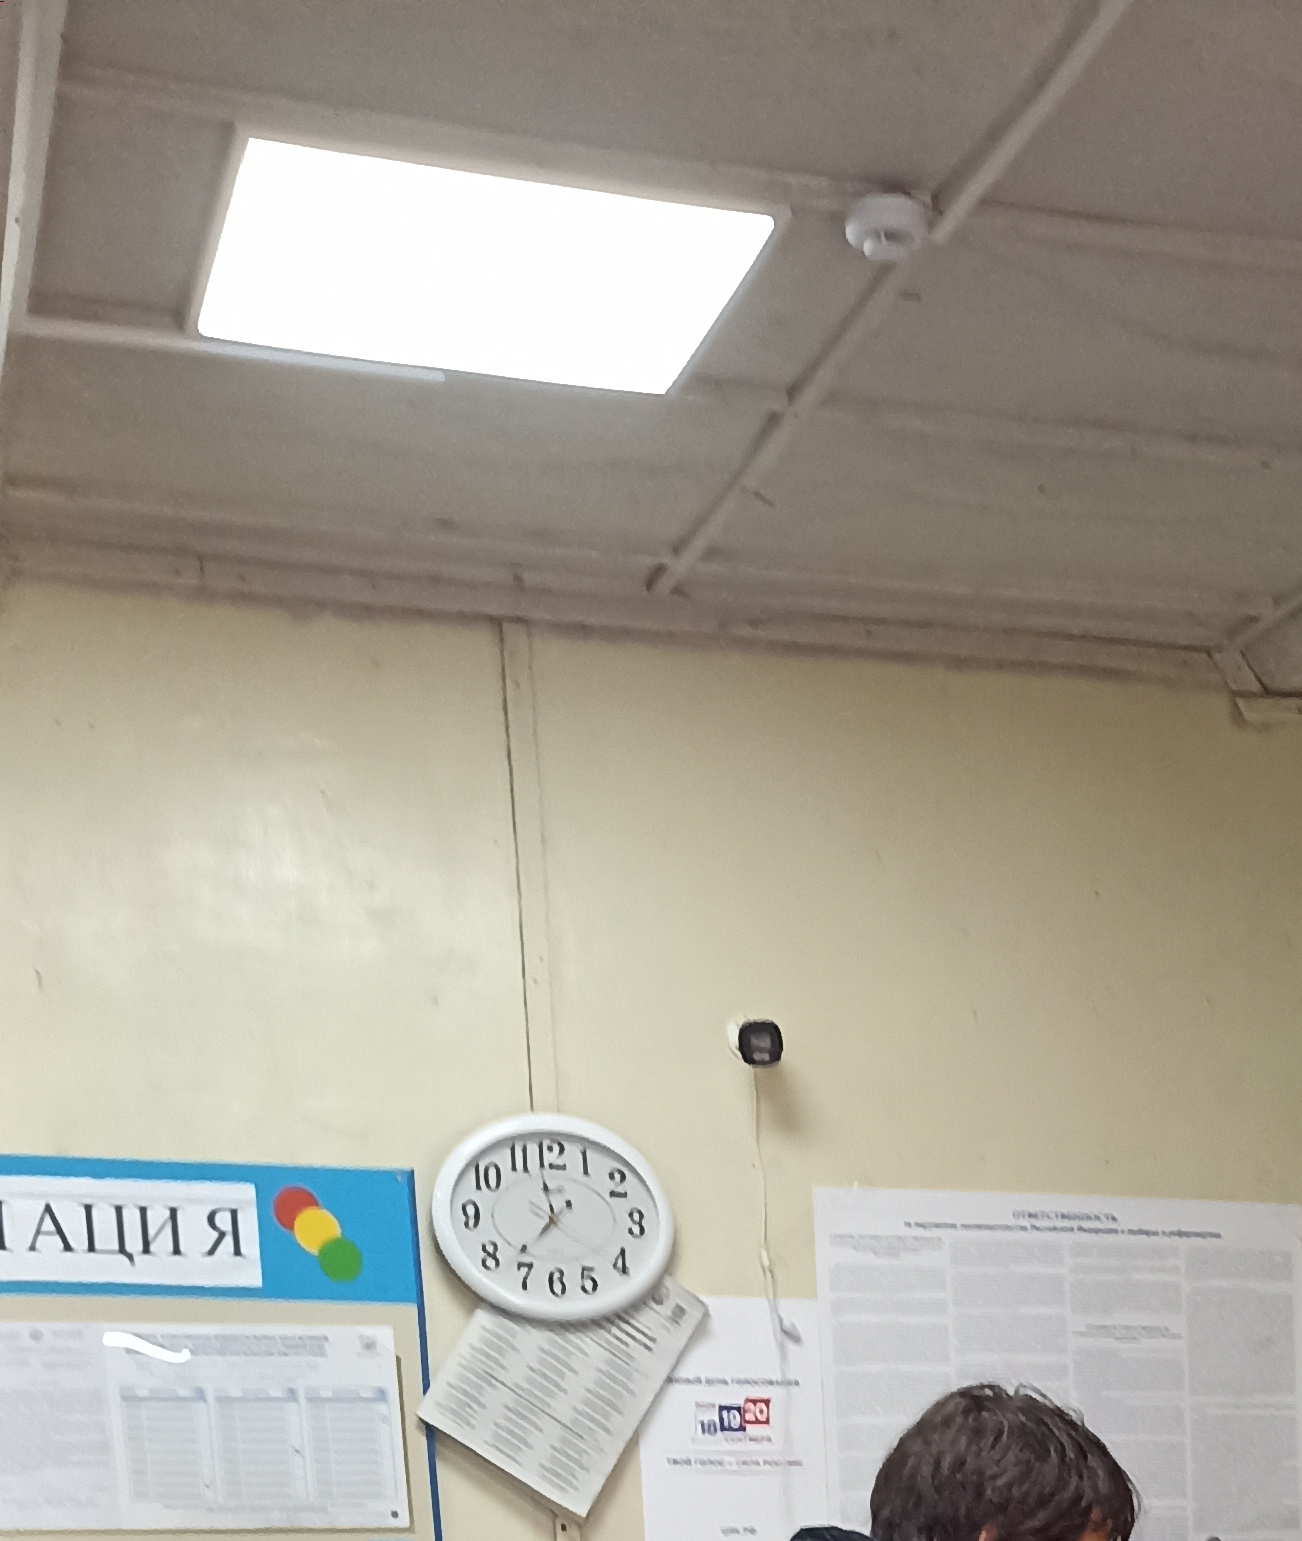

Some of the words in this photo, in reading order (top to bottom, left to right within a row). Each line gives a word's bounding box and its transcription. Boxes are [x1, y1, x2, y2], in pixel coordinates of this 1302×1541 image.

[509, 1140, 530, 1174] 11
[537, 1138, 567, 1172] 12
[579, 1145, 591, 1178] 1
[473, 1160, 502, 1193] 10
[607, 1167, 628, 1199] 2
[460, 1198, 481, 1231] 9
[626, 1206, 646, 1239] 3
[480, 1239, 501, 1272] 8
[611, 1245, 631, 1278] 4
[515, 1260, 534, 1291] 7
[547, 1266, 568, 1299] 6
[579, 1264, 599, 1296] 5
